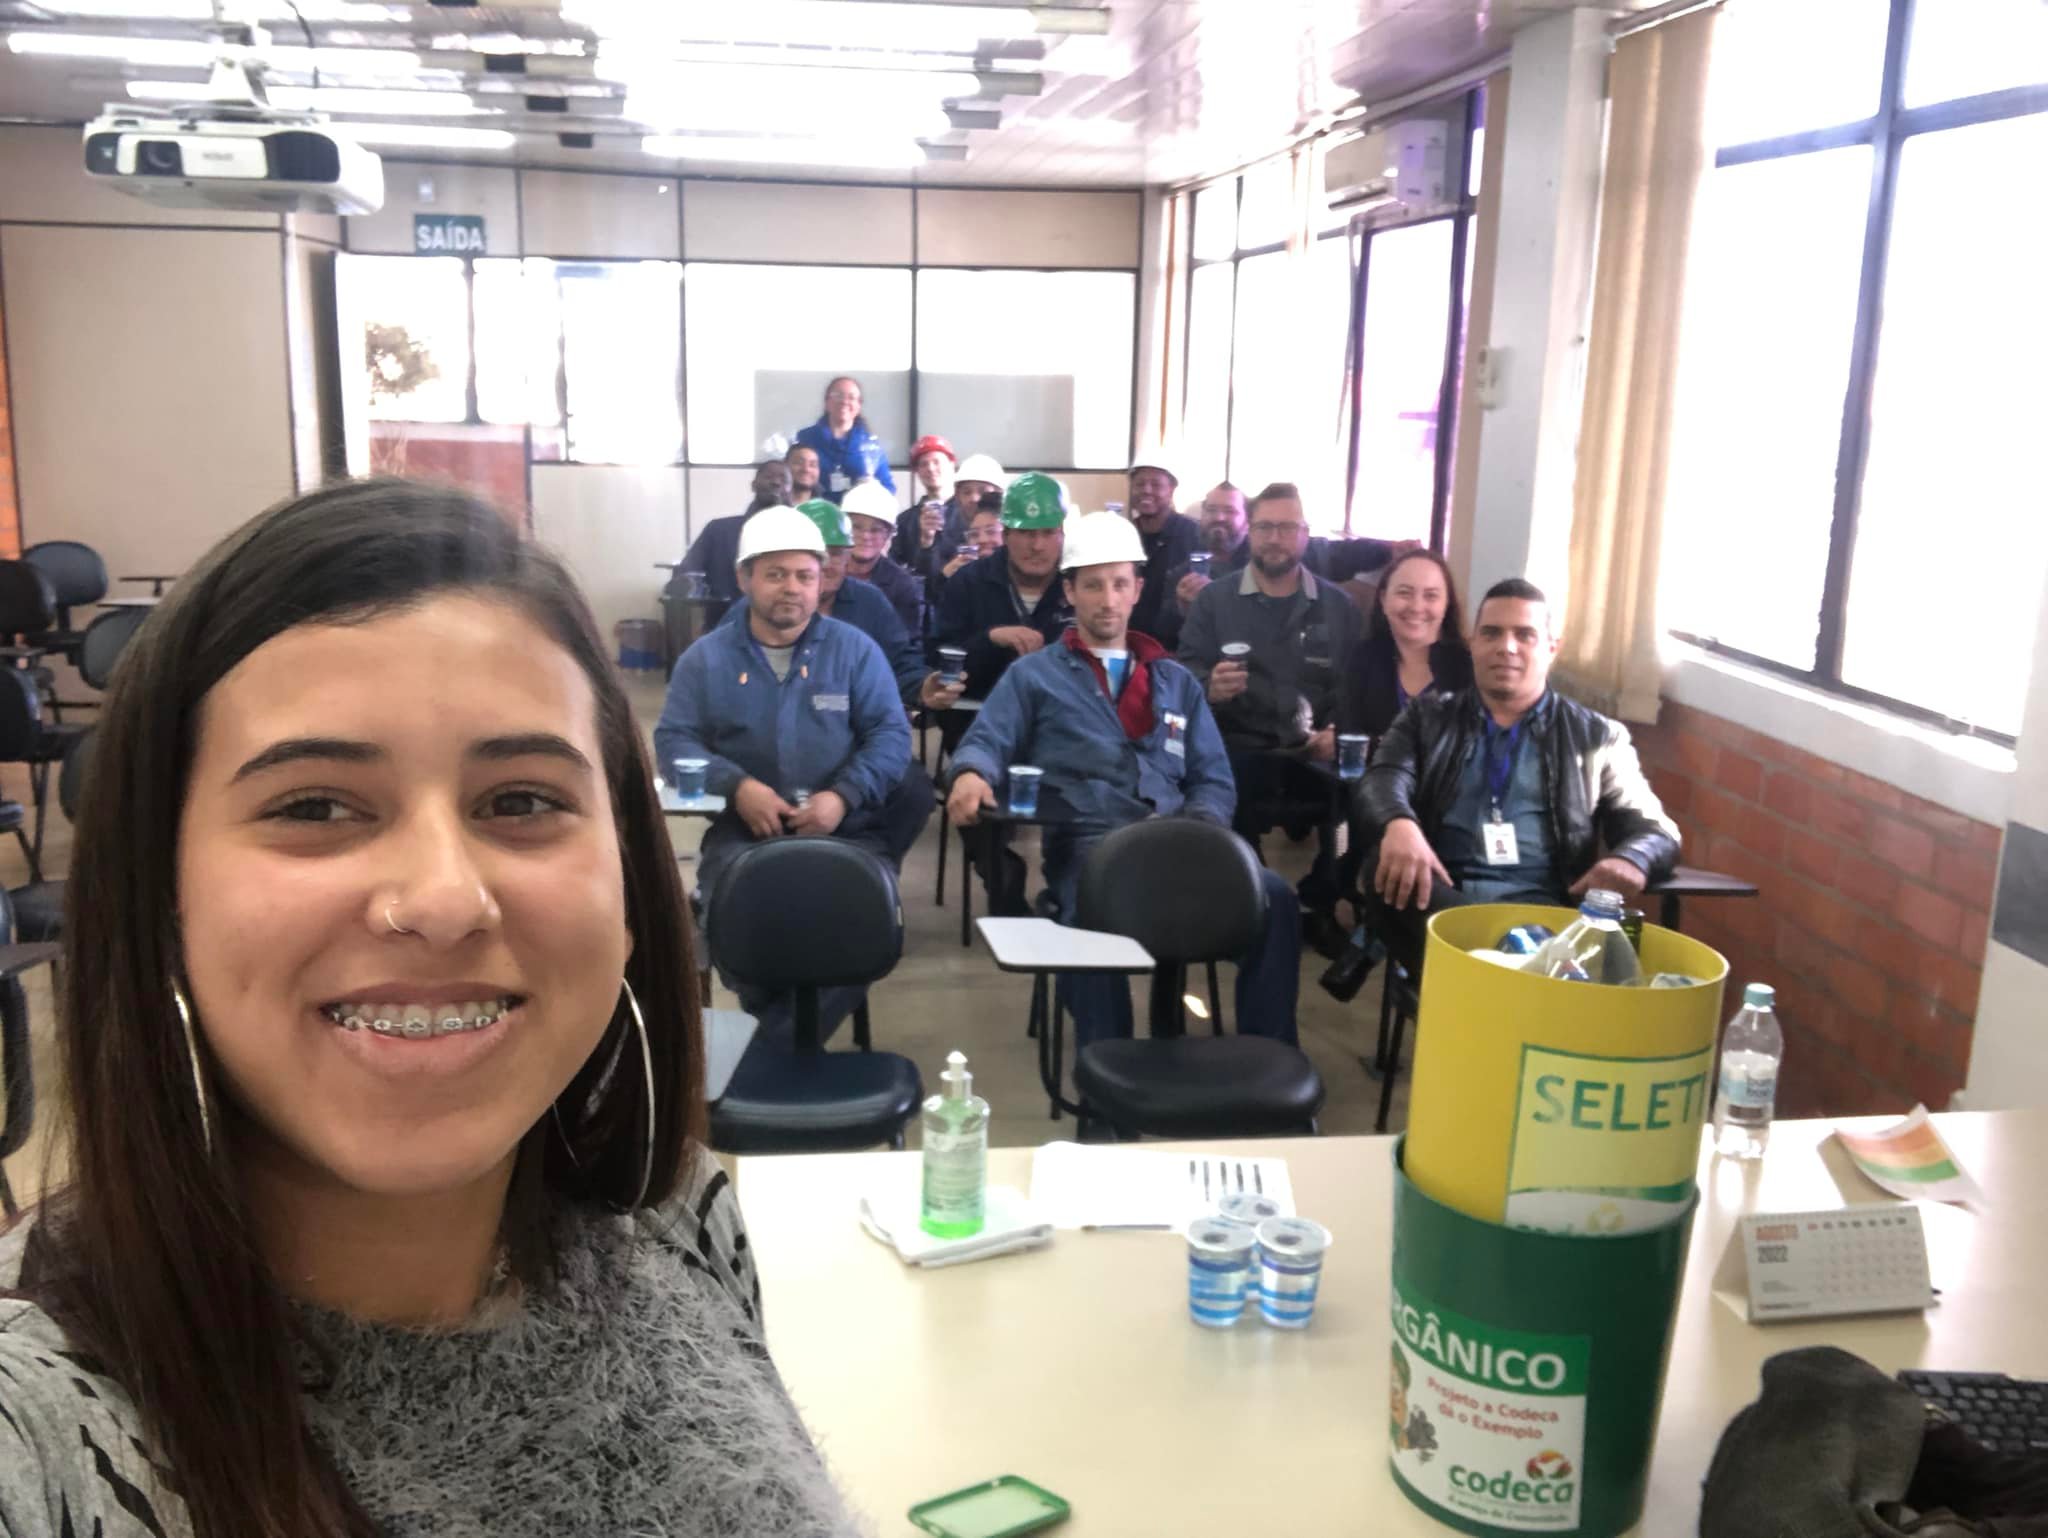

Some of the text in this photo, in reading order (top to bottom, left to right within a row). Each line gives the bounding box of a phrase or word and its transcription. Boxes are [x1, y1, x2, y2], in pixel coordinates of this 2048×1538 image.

[417, 220, 485, 250] SAÍDA
[1427, 1376, 1479, 1410] Projeto
[1498, 1404, 1559, 1423] Codeca
[1457, 1412, 1468, 1424] o
[1472, 1414, 1544, 1440] Exemplo
[1448, 1464, 1575, 1505] codeca
